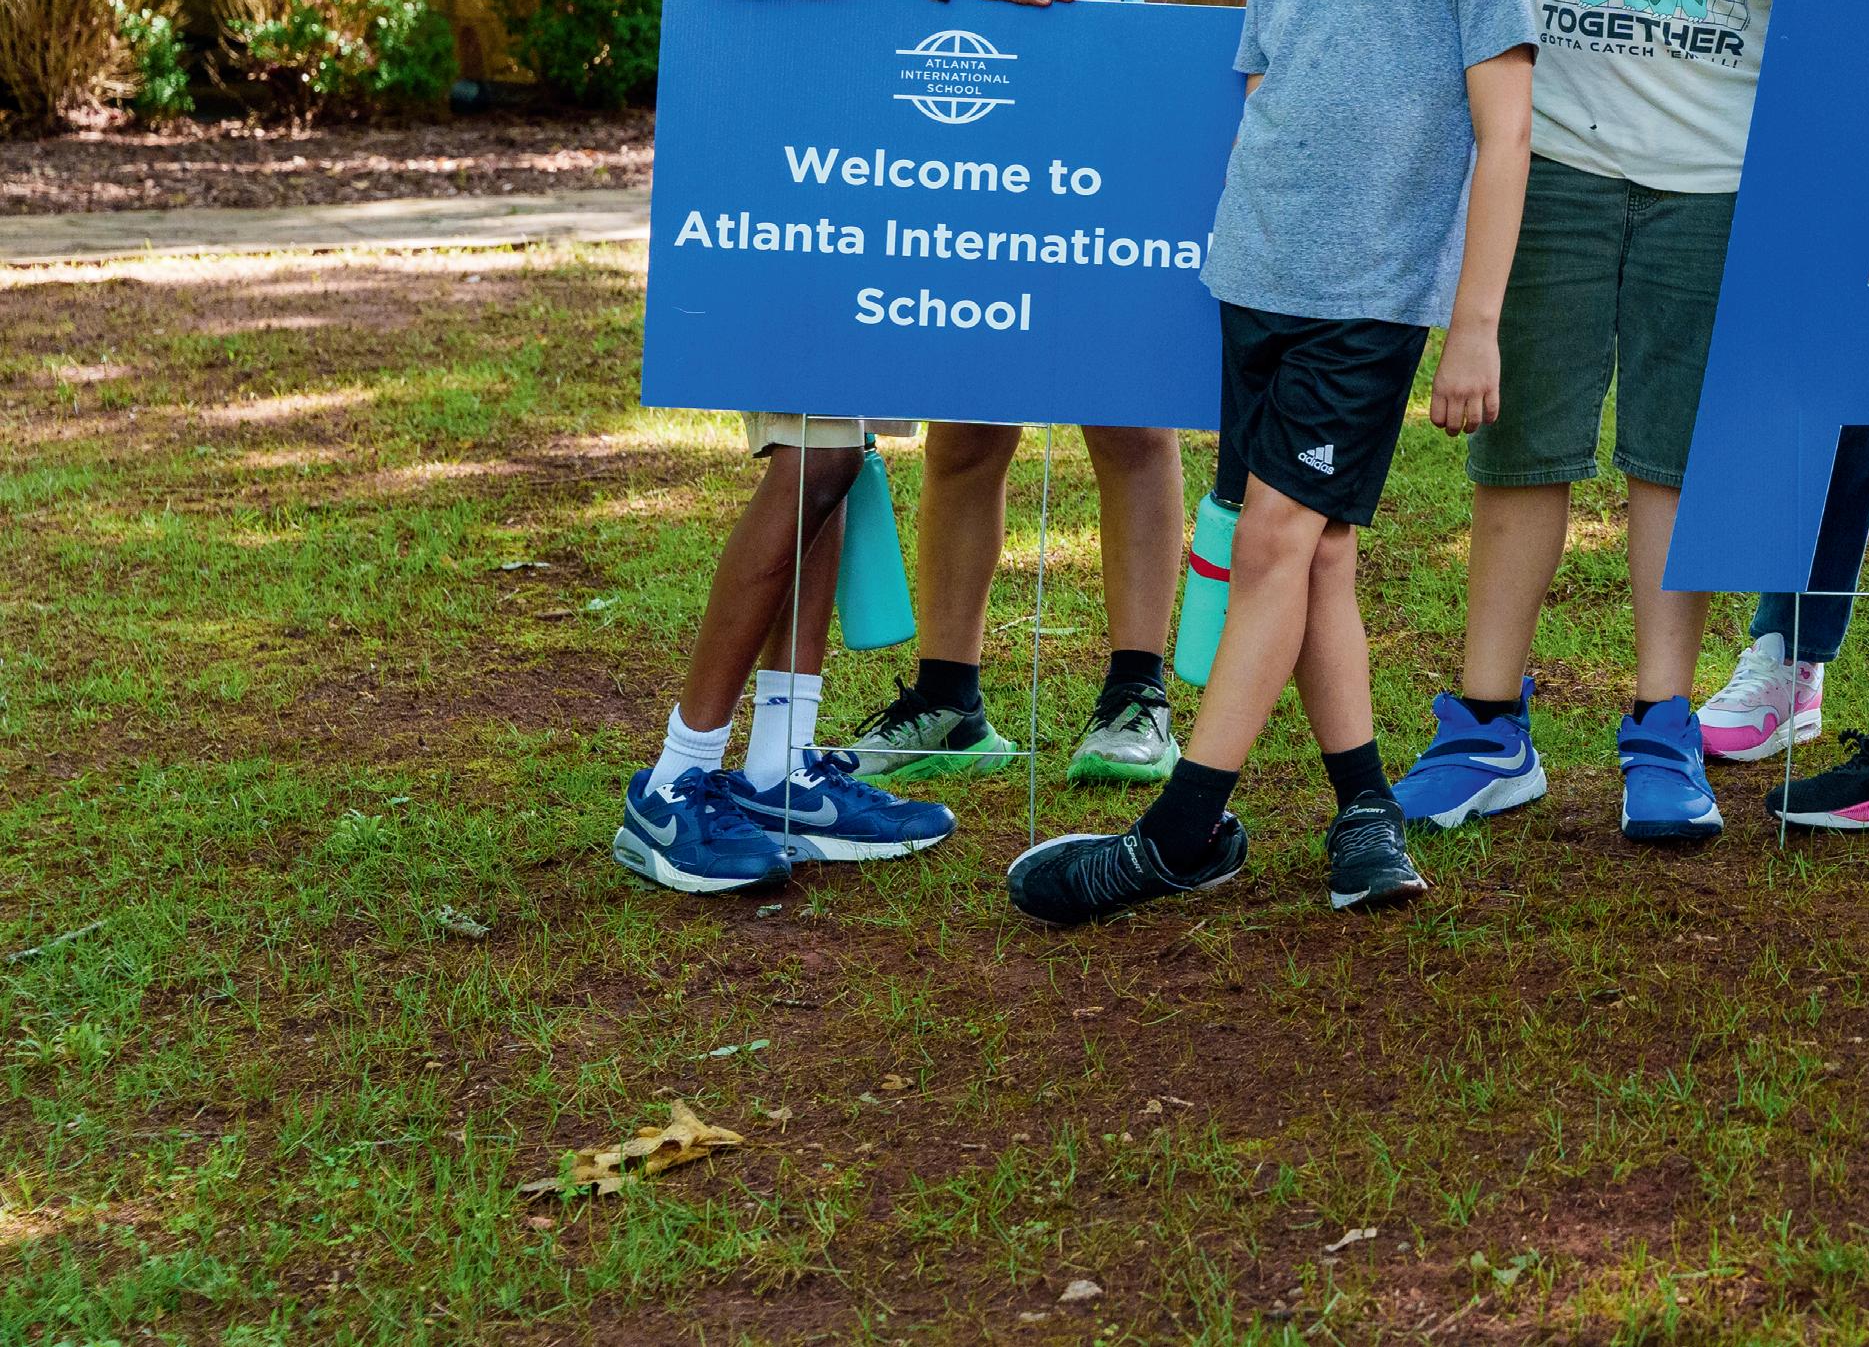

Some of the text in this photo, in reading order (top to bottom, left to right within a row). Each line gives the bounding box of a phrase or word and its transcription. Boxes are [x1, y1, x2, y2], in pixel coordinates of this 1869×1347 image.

[1542, 4, 1745, 57] TOGETHER
[1540, 33, 1582, 51] GOTTA
[1590, 42, 1654, 58] CATCH
[900, 69, 1010, 85] INTERNATIONAL
[925, 58, 987, 71] ATLANTA
[926, 83, 983, 96] SCHOOL
[784, 145, 1102, 196] Welcome to
[673, 210, 865, 255] Atlanta
[854, 287, 1032, 331] School
[1297, 452, 1335, 475] adidas
